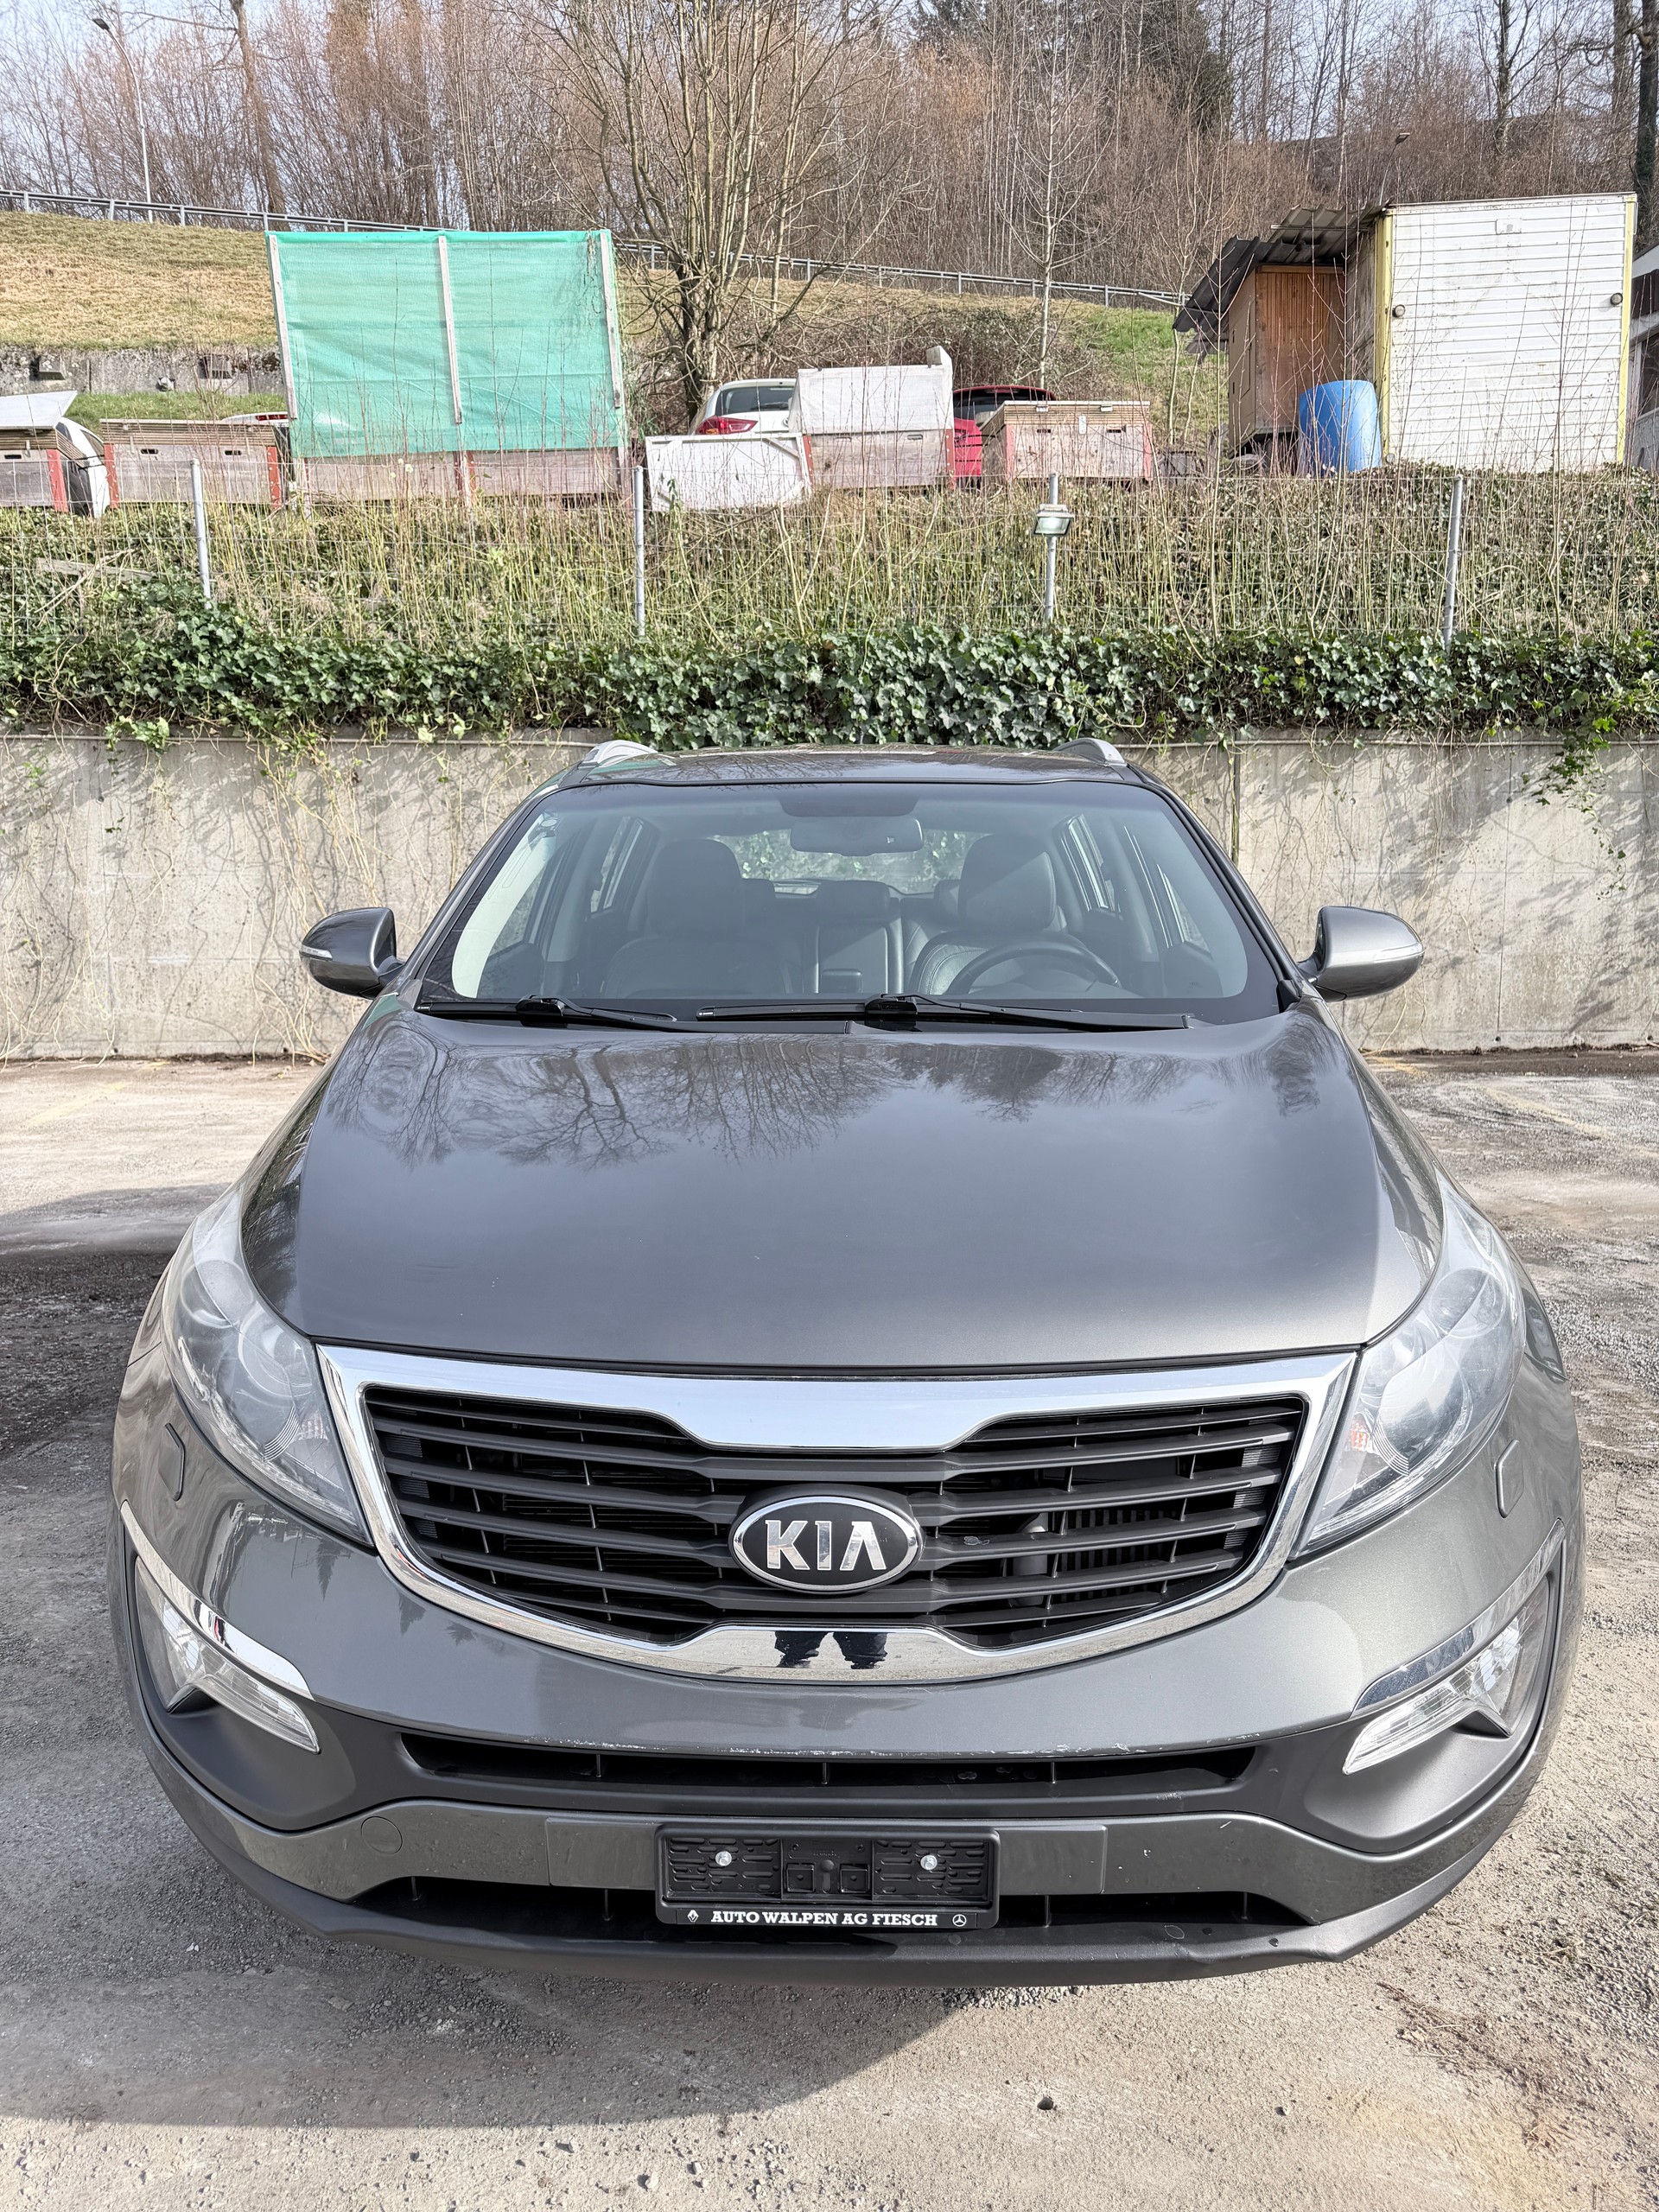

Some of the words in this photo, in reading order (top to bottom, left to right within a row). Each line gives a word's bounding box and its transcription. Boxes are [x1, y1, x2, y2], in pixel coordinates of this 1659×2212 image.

[765, 1519, 887, 1572] KIA
[710, 1910, 760, 1923] AUTO
[761, 1911, 838, 1925] WALPEN
[842, 1912, 868, 1925] AG
[872, 1913, 938, 1926] FIESCH
